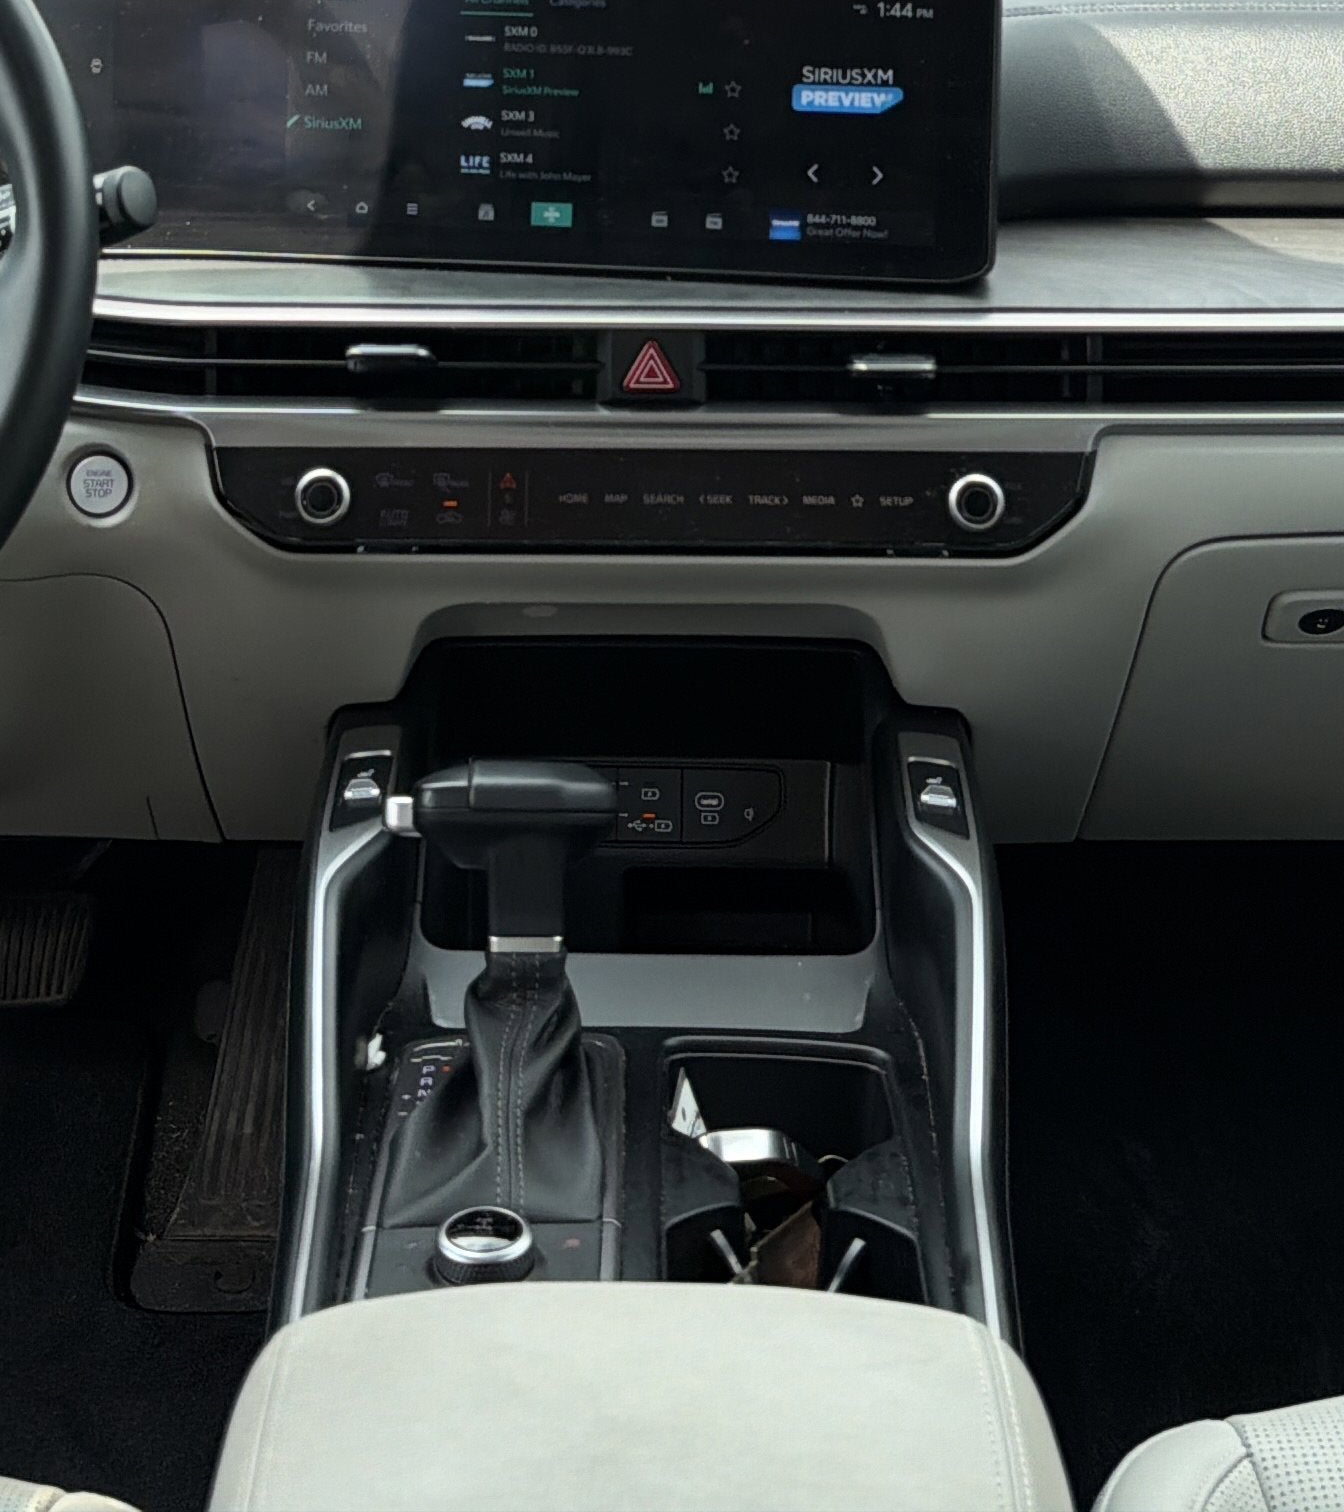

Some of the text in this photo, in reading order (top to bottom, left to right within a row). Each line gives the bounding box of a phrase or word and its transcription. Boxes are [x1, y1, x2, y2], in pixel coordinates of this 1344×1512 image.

[876, 1, 934, 19] 1:44 PM
[307, 18, 368, 33] Favorites
[504, 25, 529, 37] SXM
[306, 51, 328, 65] FM
[502, 68, 527, 80] SXM
[801, 65, 895, 85] SIRIUSXM
[304, 84, 329, 97] AM
[544, 86, 580, 97] Preview
[800, 89, 896, 108] PREVIEW
[501, 110, 526, 122] SXM
[303, 115, 362, 131] SiriusXM
[459, 154, 491, 168] LIFE
[499, 152, 525, 164] SXM
[83, 478, 115, 489] START
[85, 488, 113, 499] STOP
[558, 492, 590, 505] HOME
[604, 492, 629, 504] MAP
[642, 492, 685, 505] SEARCH
[706, 493, 734, 505] SEEK
[748, 494, 781, 506] TRACK
[802, 494, 835, 506] MEDIA
[879, 495, 914, 507] SETUP
